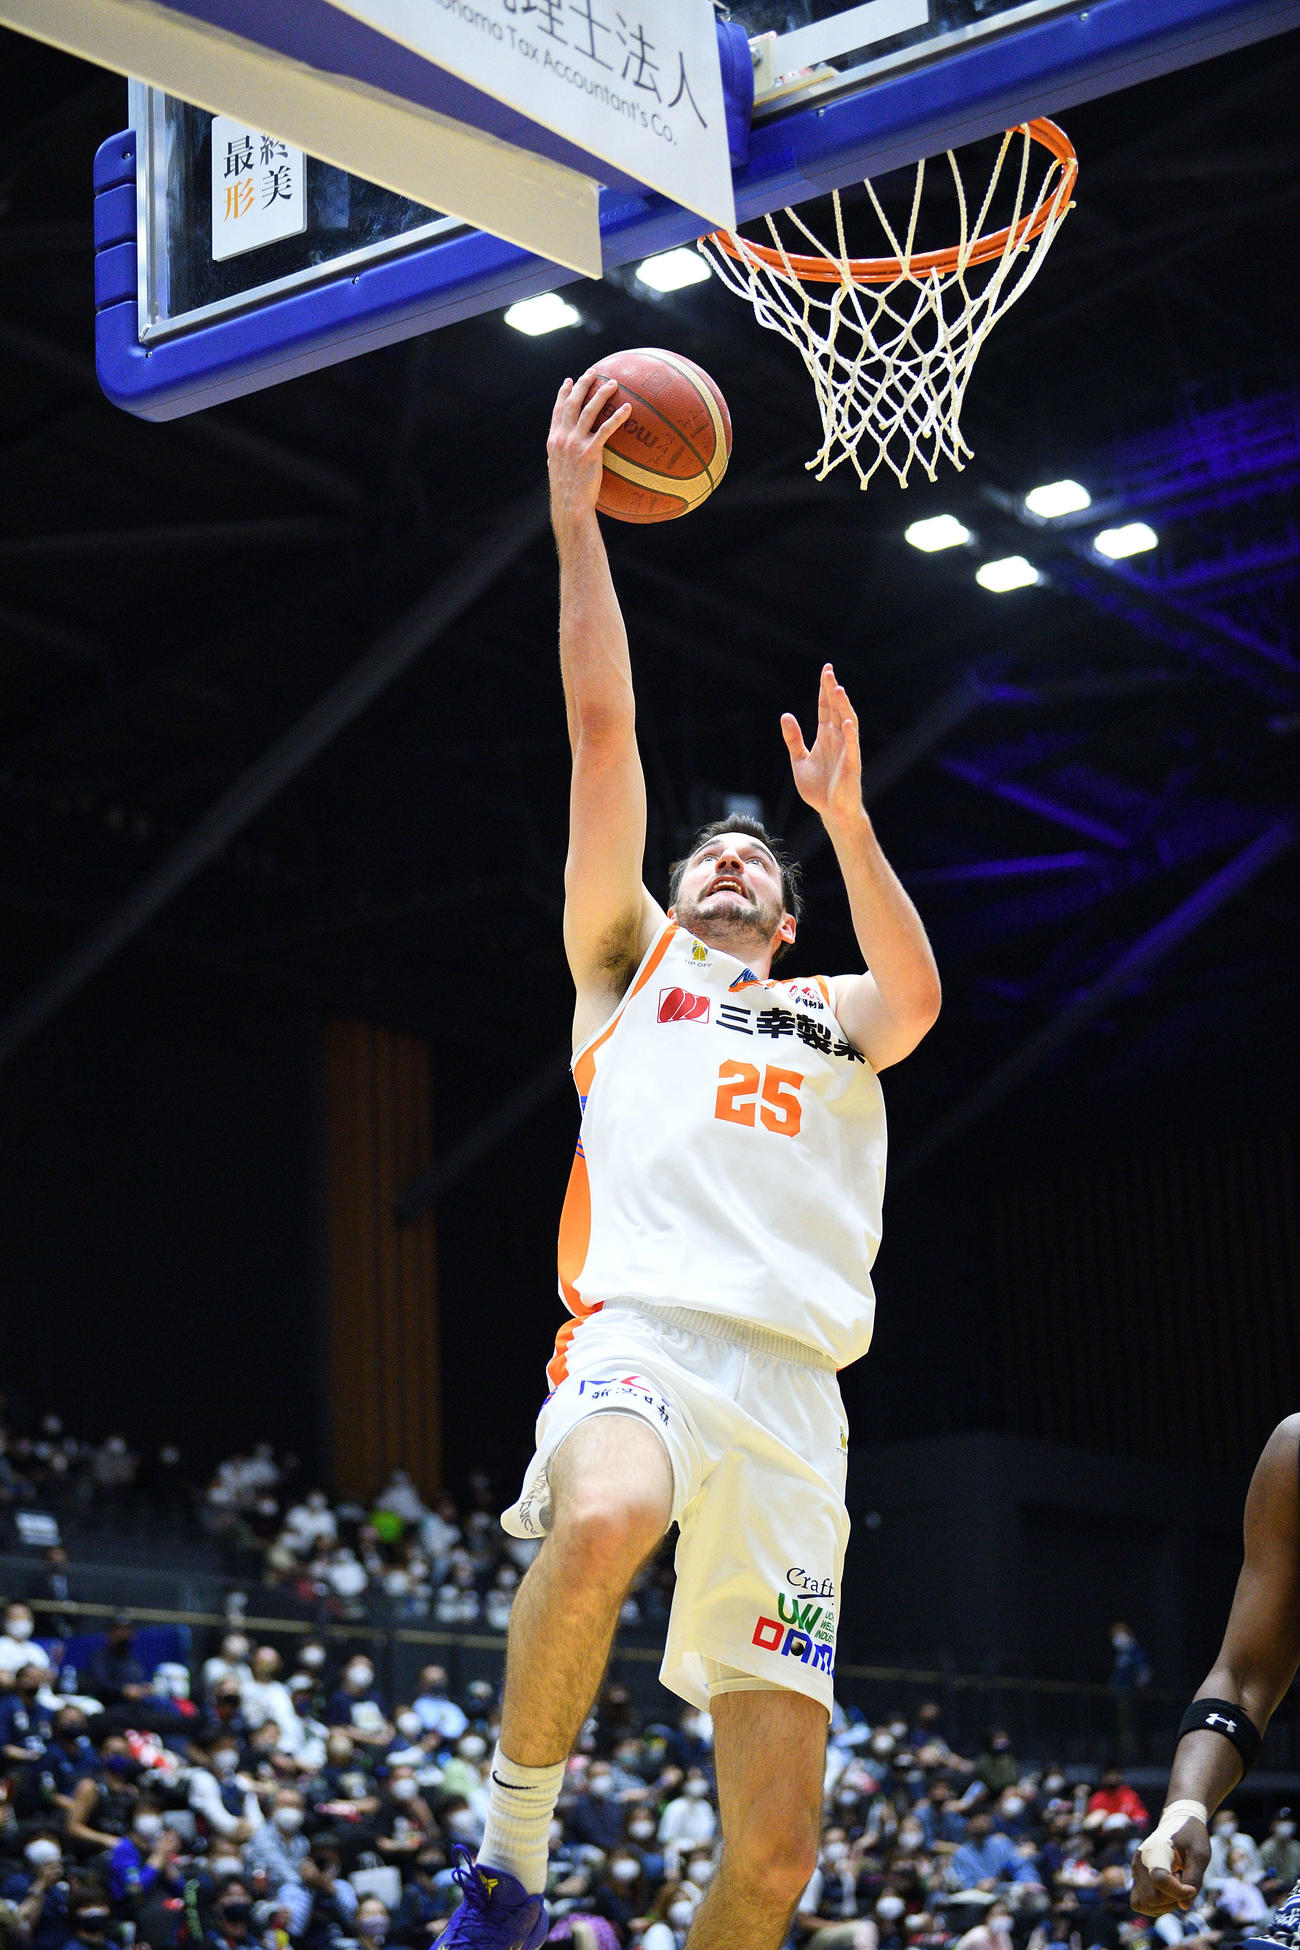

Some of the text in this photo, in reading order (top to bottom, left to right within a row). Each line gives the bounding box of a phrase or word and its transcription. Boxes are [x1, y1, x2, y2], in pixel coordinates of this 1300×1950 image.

[506, 24, 540, 64] Tax
[543, 49, 649, 128] Accountant's
[651, 113, 678, 146] Co.
[714, 1058, 805, 1138] 25
[786, 1567, 834, 1597] Craft
